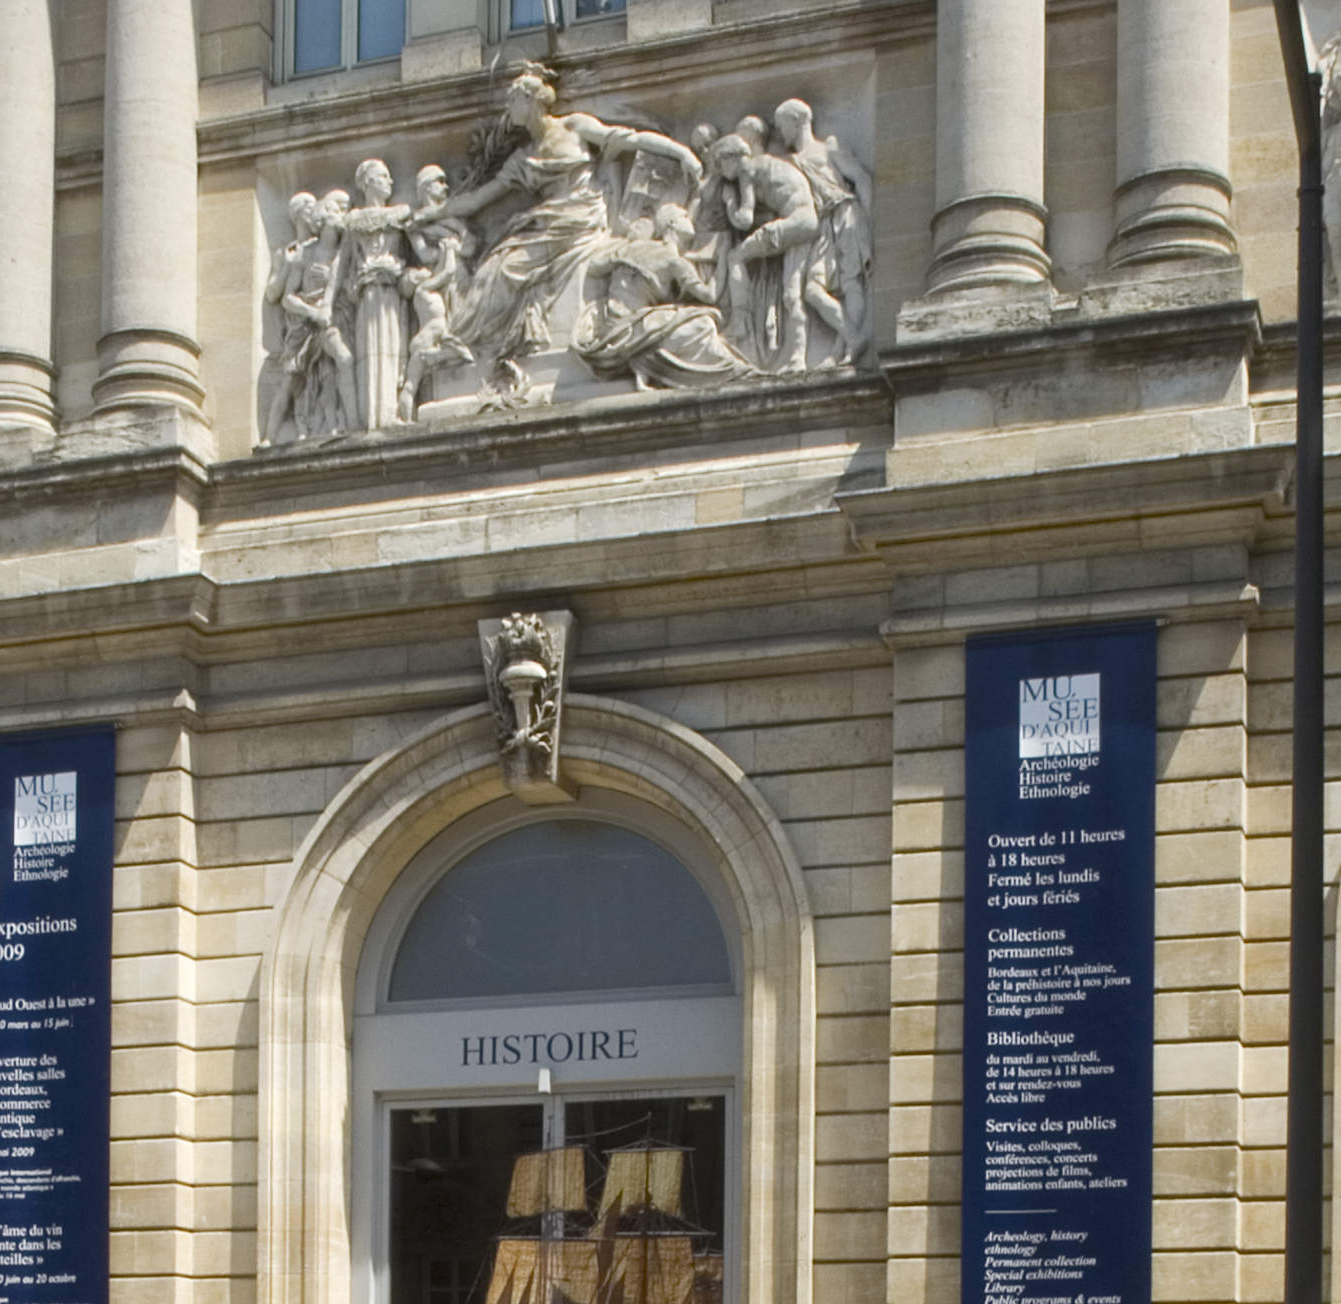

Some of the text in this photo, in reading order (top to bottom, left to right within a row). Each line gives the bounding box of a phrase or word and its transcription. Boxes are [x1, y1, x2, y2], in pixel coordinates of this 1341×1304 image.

[1022, 677, 1072, 702] MU
[1048, 692, 1098, 722] SÉE
[1022, 720, 1090, 740] D'AQUI
[1042, 738, 1097, 756] TAINE
[1019, 755, 1099, 772] Archéologie
[1019, 771, 1071, 785] Histoire
[17, 775, 56, 797] MU
[1019, 783, 1090, 799] Ethnologie
[17, 812, 69, 830] D'AQUI
[32, 828, 74, 844] TAINE
[988, 829, 1125, 848] Ouvert de 11 heures
[14, 843, 76, 858] Archéologie
[14, 857, 54, 870] Histoire
[988, 852, 1065, 868] à 18 heures
[14, 867, 68, 882] Ethnologie
[988, 868, 1100, 887] Fermé les lundis
[987, 889, 1080, 909] et jours fériés
[988, 928, 1066, 942] Collections
[988, 945, 1074, 962] permanentes
[988, 967, 1038, 978] Bordeaux
[1041, 967, 1051, 977] et
[987, 975, 1131, 993] de la préhistoire à nos jours
[15, 998, 46, 1011] Ouest
[48, 997, 55, 1009] à
[56, 996, 66, 1008] la
[67, 997, 86, 1008] une
[987, 989, 1087, 1003] Cultures du monde
[987, 1004, 1064, 1019] Entrée gratuite
[7, 1021, 29, 1029] mars
[30, 1021, 42, 1029] au
[44, 1018, 54, 1028] 15
[54, 1018, 69, 1030] juin
[987, 1031, 1074, 1047] Bibliothèque
[460, 1029, 639, 1066] HISTOIRE
[39, 1054, 58, 1066] des
[986, 1051, 1100, 1065] du mardi au vendredi,
[36, 1067, 66, 1081] salles
[986, 1064, 1115, 1078] de 14 heures à 18 heures
[986, 1079, 1082, 1091] et sur rendez-vous
[986, 1092, 1045, 1103] Accès libre
[986, 1116, 1116, 1134] Service des publics
[11, 1147, 35, 1157] 2009
[986, 1140, 1081, 1153] Visites, colloques,
[985, 1153, 1098, 1165] conférences, concerts
[985, 1165, 1092, 1180] projections de films,
[985, 1176, 1128, 1191] animations enfants, ateliers
[29, 1224, 43, 1237] du
[45, 1223, 63, 1236] vin
[984, 1230, 1088, 1244] Archeology, history
[18, 1238, 44, 1251] dans
[47, 1238, 62, 1250] les
[984, 1243, 1037, 1257] ethnology
[984, 1255, 1096, 1268] Permanent collection
[4, 1275, 21, 1286] juin
[22, 1276, 34, 1284] au
[36, 1273, 47, 1284] 20
[48, 1273, 76, 1283] octobre
[984, 1268, 1083, 1283] Special exhibitions
[984, 1280, 1025, 1295] Library
[1074, 1294, 1084, 1304] &
[1087, 1295, 1121, 1304] events
